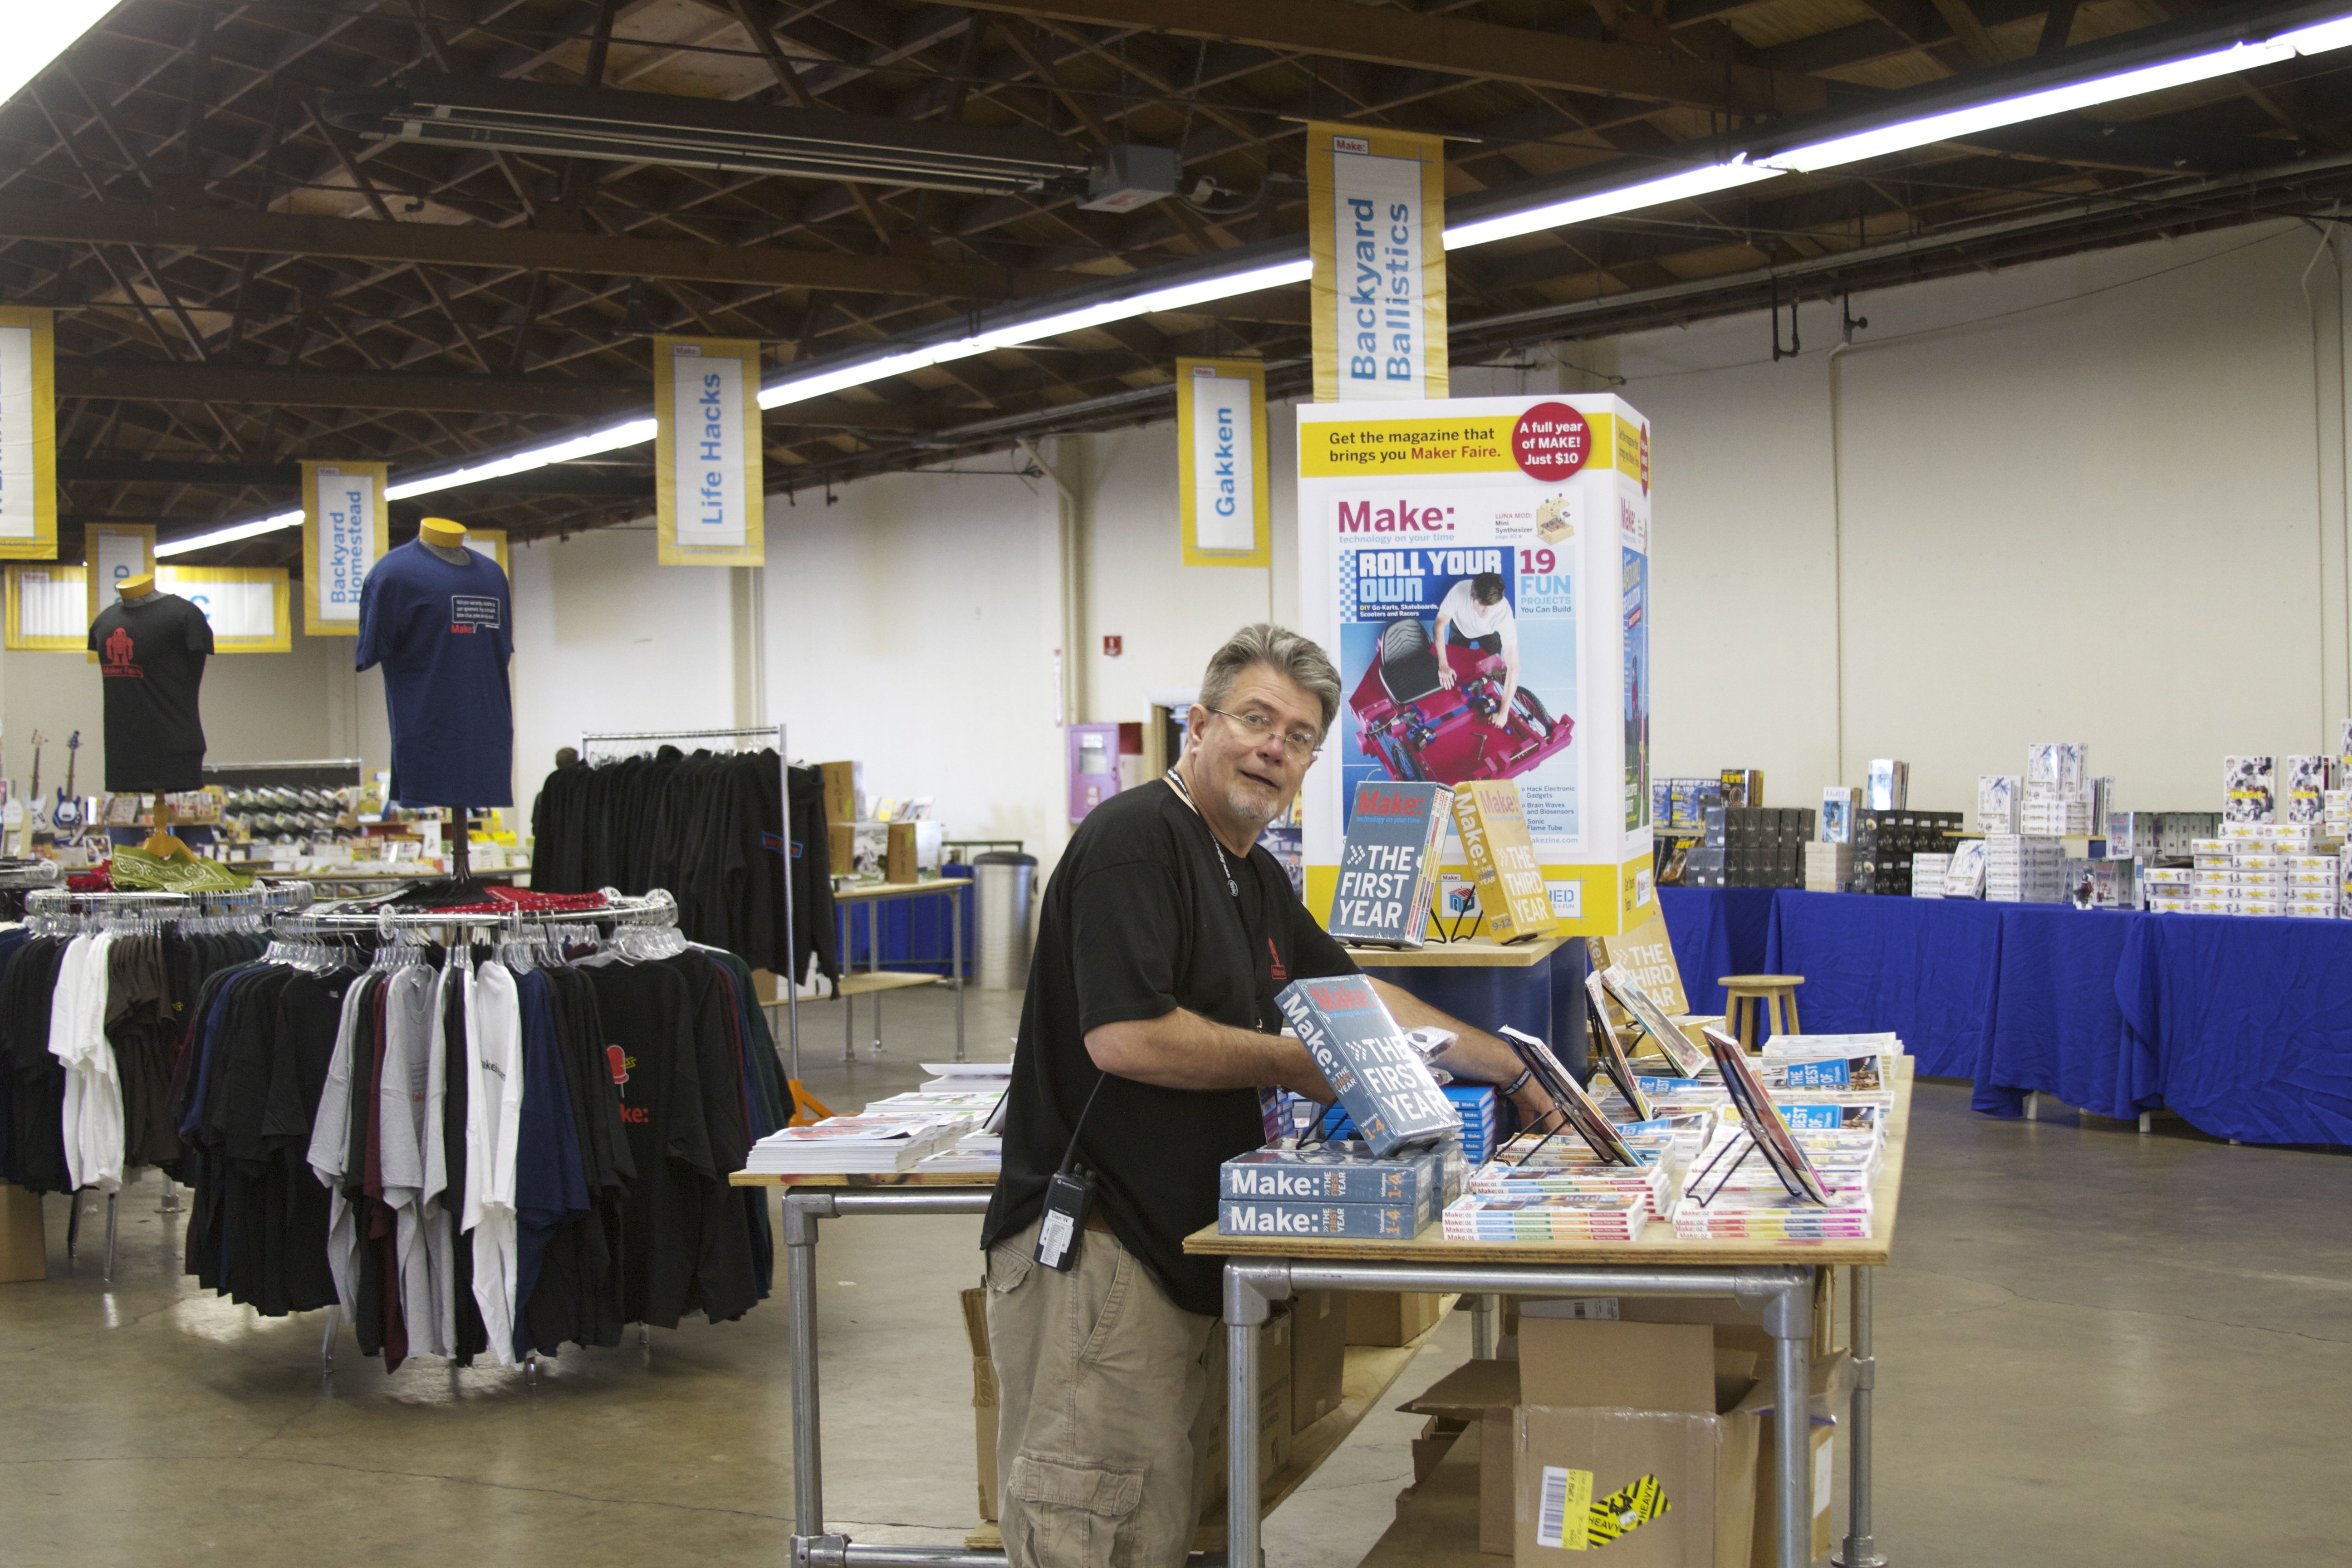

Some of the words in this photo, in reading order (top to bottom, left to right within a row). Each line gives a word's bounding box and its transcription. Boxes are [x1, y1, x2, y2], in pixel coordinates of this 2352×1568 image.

[1336, 139, 1366, 152] Make:
[1348, 198, 1382, 379] Backyard
[1385, 203, 1411, 381] Ballistics
[699, 373, 721, 461] Hacks
[1519, 423, 1529, 434] A
[1531, 421, 1552, 433] full
[1555, 422, 1583, 435] year
[1329, 432, 1355, 445] Get
[1360, 431, 1384, 444] the
[1388, 429, 1460, 445] magazine
[1464, 427, 1494, 440] that
[1522, 439, 1535, 449] of
[1539, 437, 1581, 449] MAKE!
[1214, 408, 1235, 517] Gakken
[1330, 449, 1376, 464] brings
[1380, 451, 1407, 463] you
[1411, 447, 1455, 460] Maker
[1461, 446, 1501, 458] Faire.
[1524, 454, 1552, 466] Just
[1555, 453, 1578, 466] $10
[701, 472, 723, 524] Life
[1338, 500, 1455, 534] Make:
[345, 490, 363, 603] Homestead
[1339, 534, 1392, 544] technology
[1409, 534, 1430, 543] your
[1432, 533, 1455, 541] time
[329, 511, 349, 603] Backyard
[1359, 551, 1425, 577] ROLL
[1426, 549, 1502, 576] YOUR
[1520, 549, 1556, 574] 19
[1520, 575, 1571, 596] FUN
[1357, 789, 1426, 816] Make:
[1479, 790, 1519, 814] Make:
[1455, 792, 1487, 866] Make:
[1368, 845, 1415, 872] THE
[1506, 846, 1535, 870] THE
[1340, 872, 1410, 899] FIRST
[1479, 877, 1496, 886] YEAR
[1504, 871, 1544, 897] THIRD
[1339, 900, 1402, 929] YEAR
[1513, 898, 1549, 922] YEAR
[1492, 918, 1512, 931] 9-12
[1588, 937, 1603, 965] ke:
[1628, 943, 1668, 966] THE
[1309, 985, 1377, 1011] Make:
[1282, 993, 1338, 1075] Make:
[1540, 1045, 1552, 1062] Make:
[1334, 1072, 1352, 1090] FIRST
[1336, 1066, 1349, 1079] THE
[1362, 1064, 1430, 1094] FIRST
[1791, 1070, 1803, 1085] THE
[1805, 1065, 1818, 1084] BEST
[1821, 1072, 1833, 1083] OF
[1338, 1078, 1357, 1096] YEAR
[620, 1103, 640, 1123] ke:
[1382, 1088, 1450, 1122] YEAR
[1364, 1117, 1385, 1141] 1-4
[1792, 1107, 1808, 1129] BEST
[1808, 1118, 1823, 1128] OF
[1232, 1169, 1319, 1196] Make:
[1338, 1171, 1346, 1197] YEAR
[1388, 1172, 1402, 1198] 1-4
[1052, 1212, 1062, 1220] Dan
[1231, 1206, 1318, 1232] Make:
[1337, 1208, 1345, 1233] YEAR
[1387, 1209, 1401, 1235] 1-4
[1639, 1483, 1653, 1519] HEAVY
[1588, 1515, 1621, 1532] HEAVY
